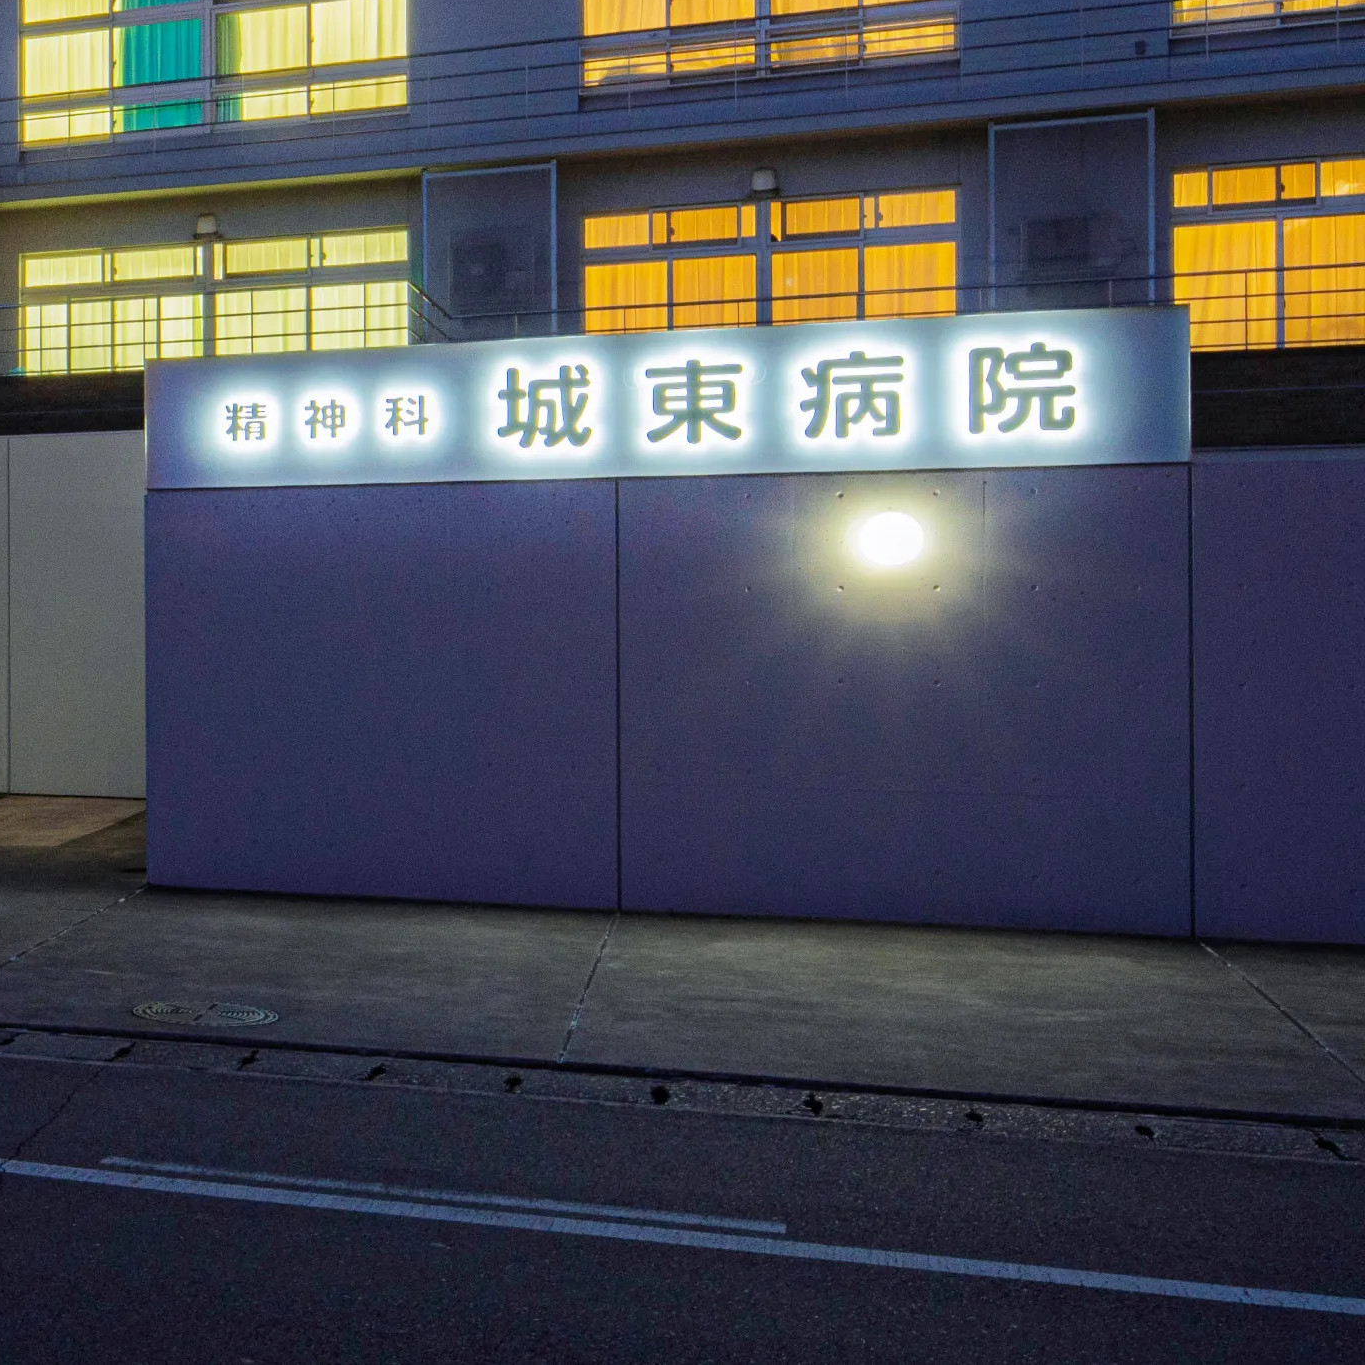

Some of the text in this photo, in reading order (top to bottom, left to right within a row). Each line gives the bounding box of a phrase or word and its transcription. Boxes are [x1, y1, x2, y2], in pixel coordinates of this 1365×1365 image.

[223, 342, 1077, 449] 精神科 城東病院
